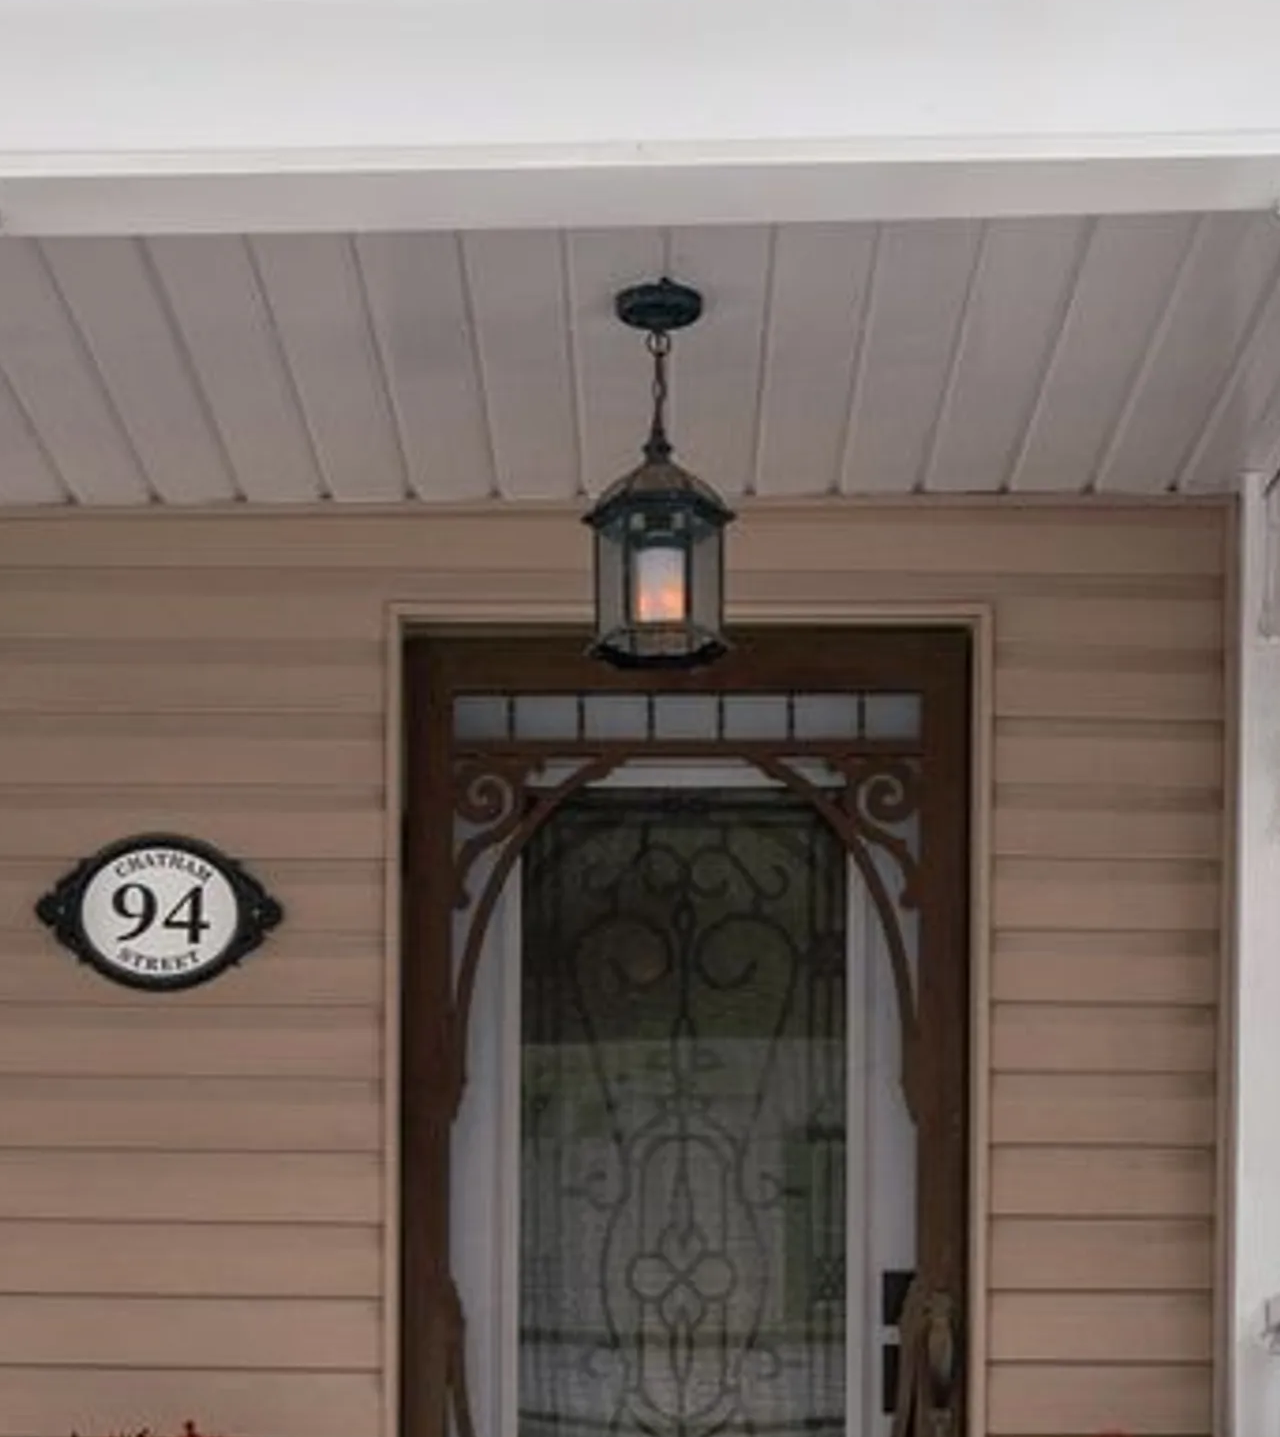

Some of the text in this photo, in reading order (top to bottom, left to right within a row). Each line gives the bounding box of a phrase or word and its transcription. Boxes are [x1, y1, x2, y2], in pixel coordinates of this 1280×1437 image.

[115, 852, 212, 882] CHATHAM
[112, 883, 210, 944] 94
[119, 948, 200, 971] STREET
